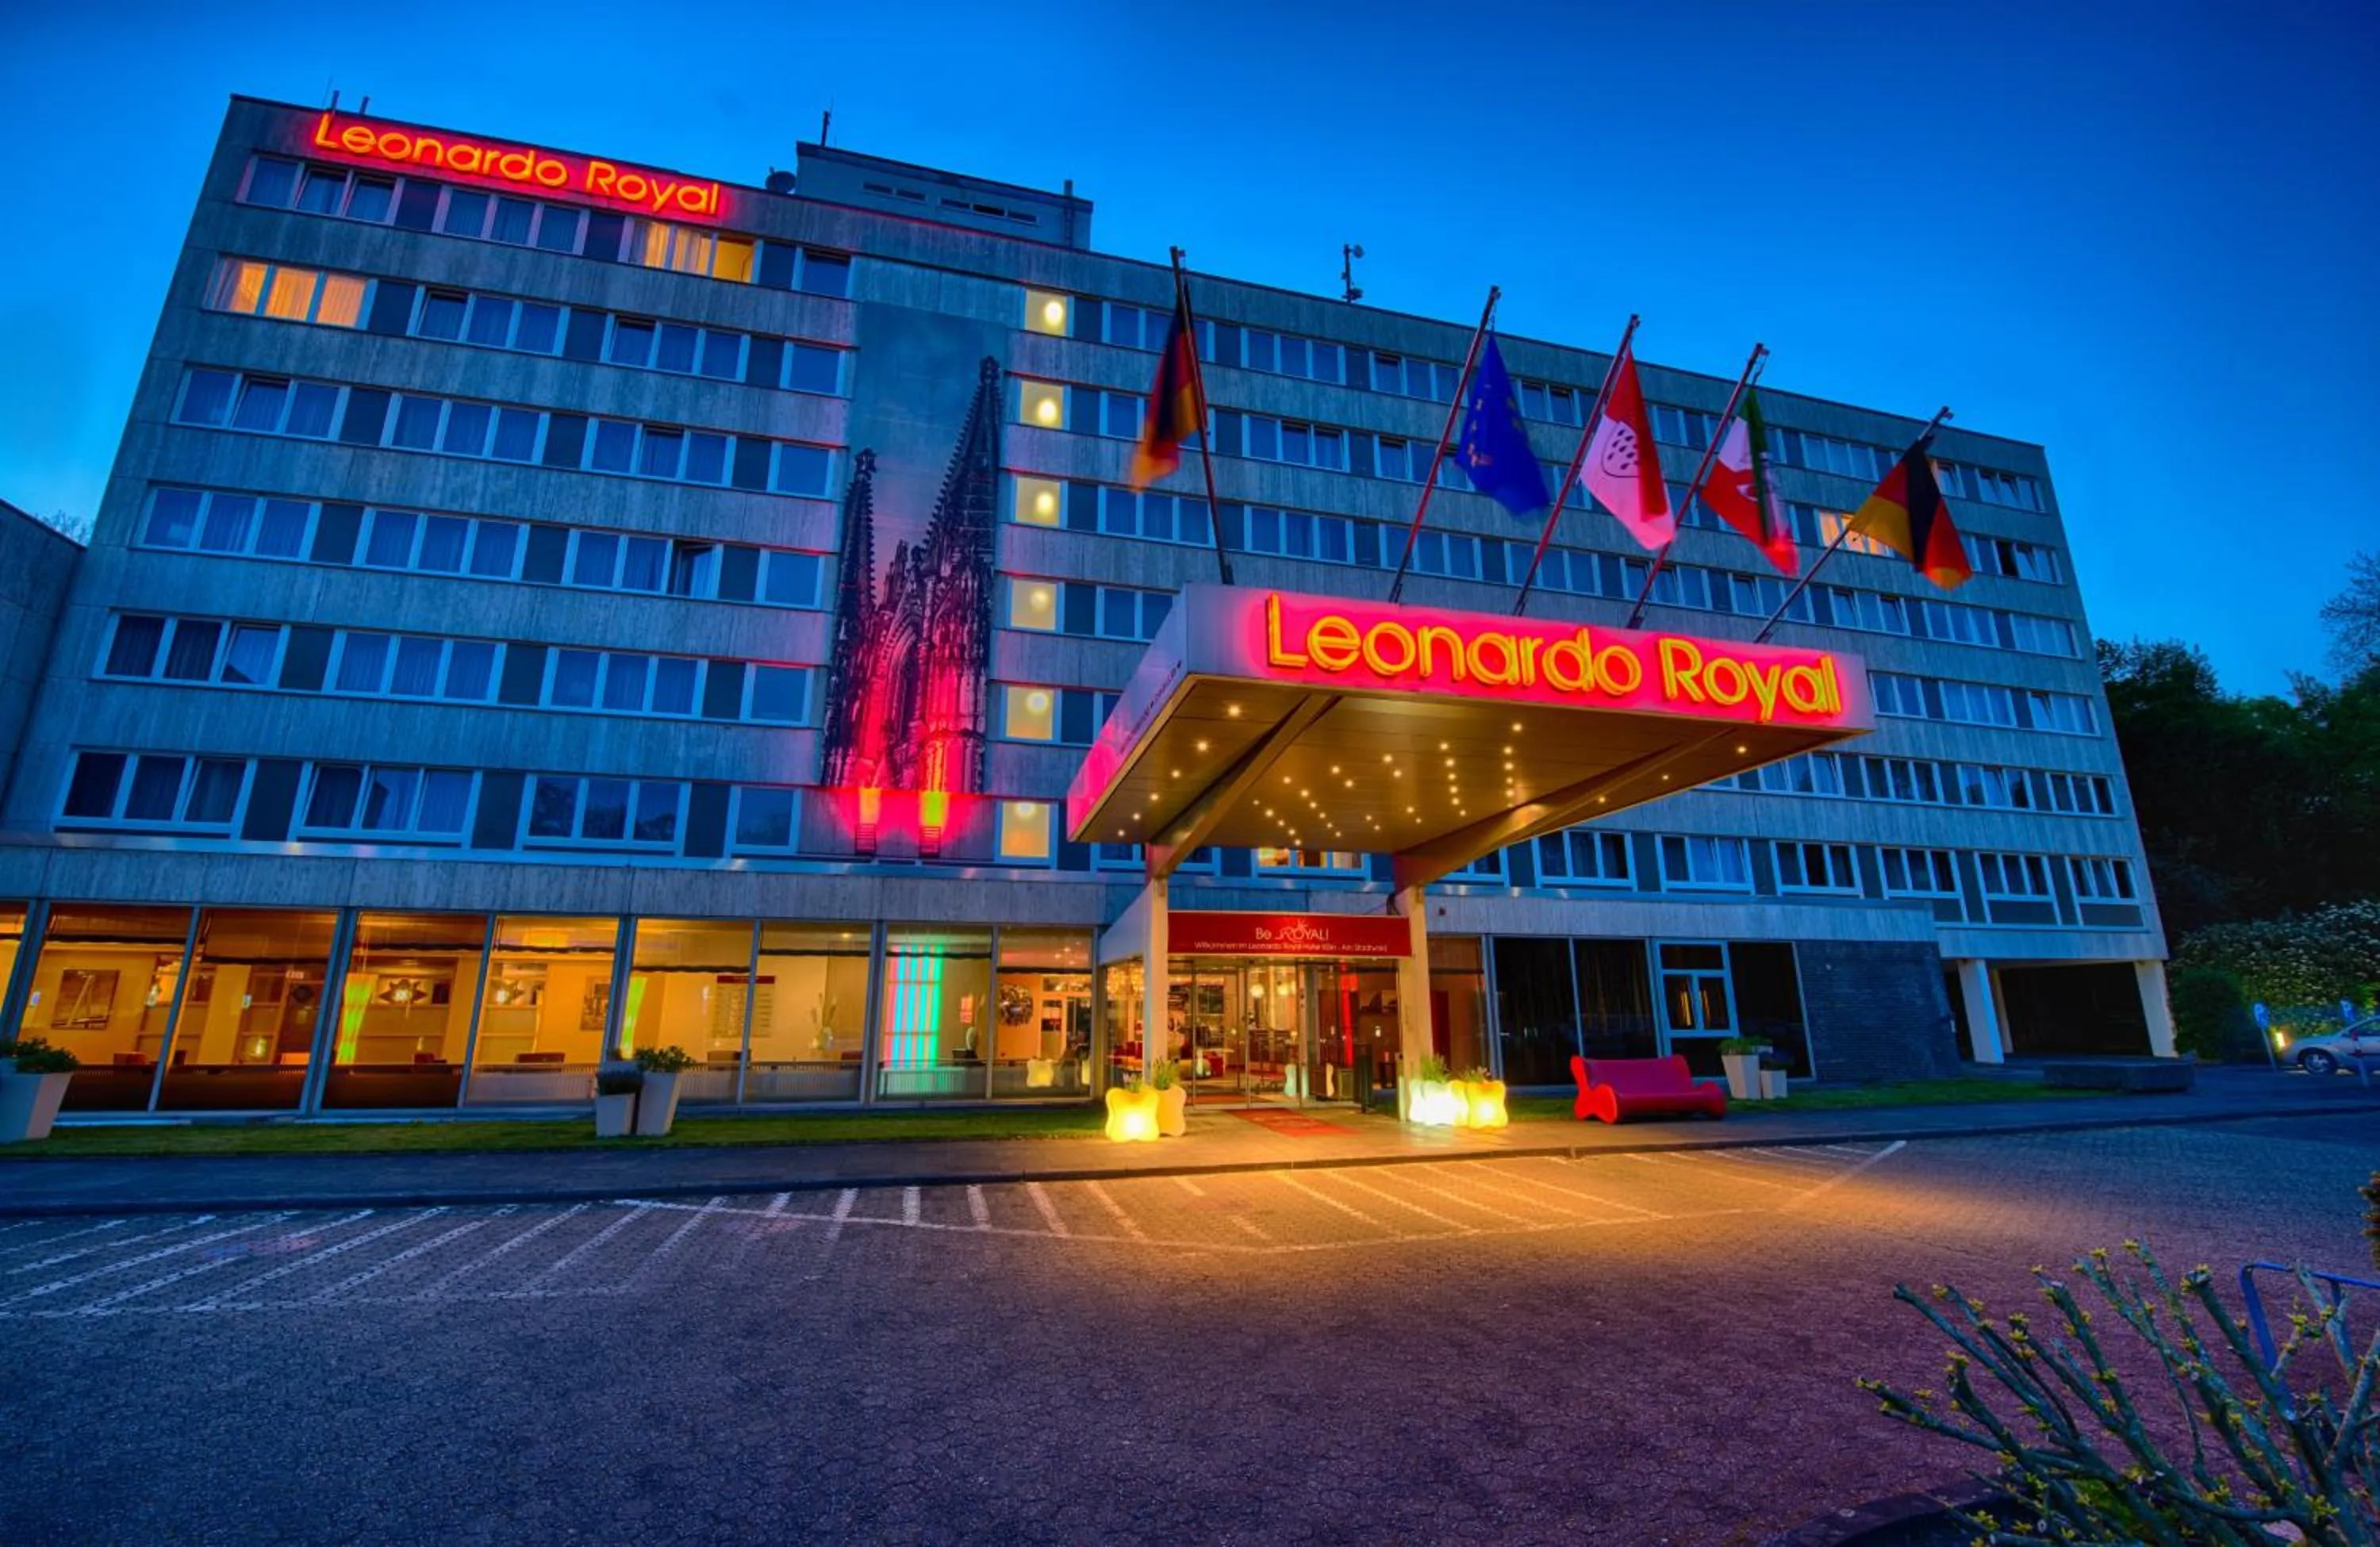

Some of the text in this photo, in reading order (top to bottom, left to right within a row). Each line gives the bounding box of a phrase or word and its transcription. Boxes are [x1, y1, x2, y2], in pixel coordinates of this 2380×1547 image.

[315, 113, 720, 215] Leonardo Royal
[1267, 593, 1842, 722] Leonardo Royal
[1256, 927, 1272, 940] Be
